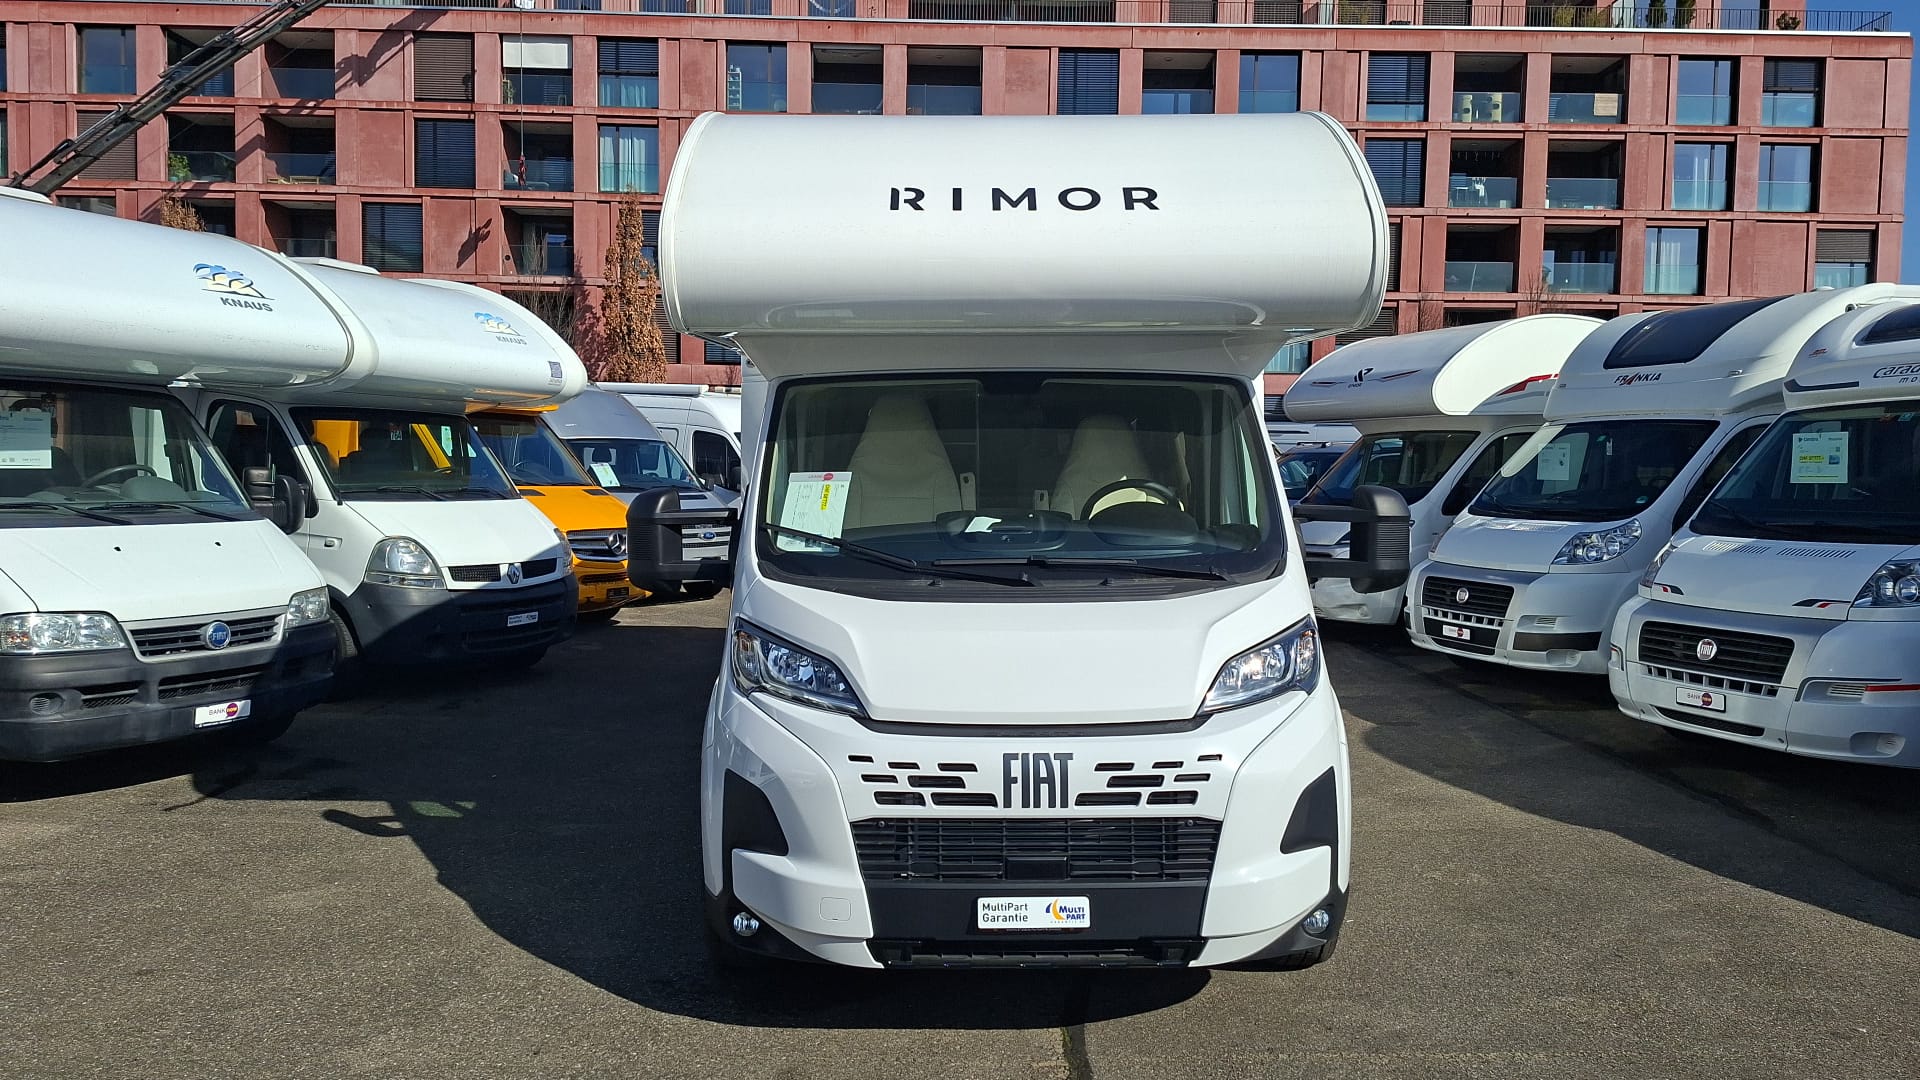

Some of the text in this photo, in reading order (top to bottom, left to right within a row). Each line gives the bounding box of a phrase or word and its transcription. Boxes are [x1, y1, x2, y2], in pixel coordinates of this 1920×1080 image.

[889, 187, 1160, 211] RIMOR
[220, 297, 273, 312] KNAUS
[496, 336, 527, 345] KNAUS
[1613, 371, 1662, 386] FRANKIA
[212, 631, 227, 641] FIAT
[208, 708, 226, 716] BANK
[1002, 752, 1074, 809] FIAT
[982, 902, 1029, 912] MultiPart
[982, 913, 1029, 923] Garantie
[1066, 913, 1086, 921] PART
